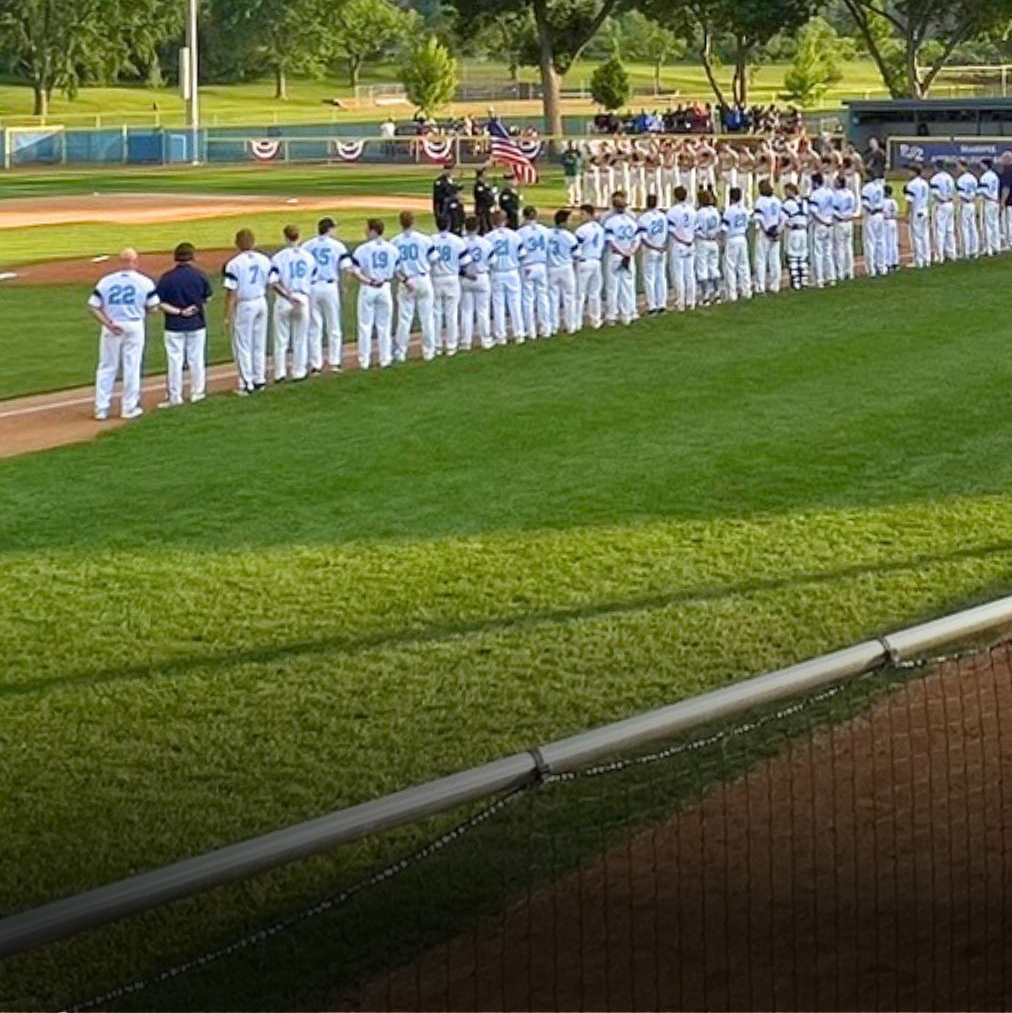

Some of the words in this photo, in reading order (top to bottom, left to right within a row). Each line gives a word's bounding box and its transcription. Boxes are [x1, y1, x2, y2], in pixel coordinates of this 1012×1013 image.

[288, 259, 307, 279] 16
[371, 250, 388, 269] 19
[249, 265, 260, 284] 7
[108, 284, 136, 305] 22
